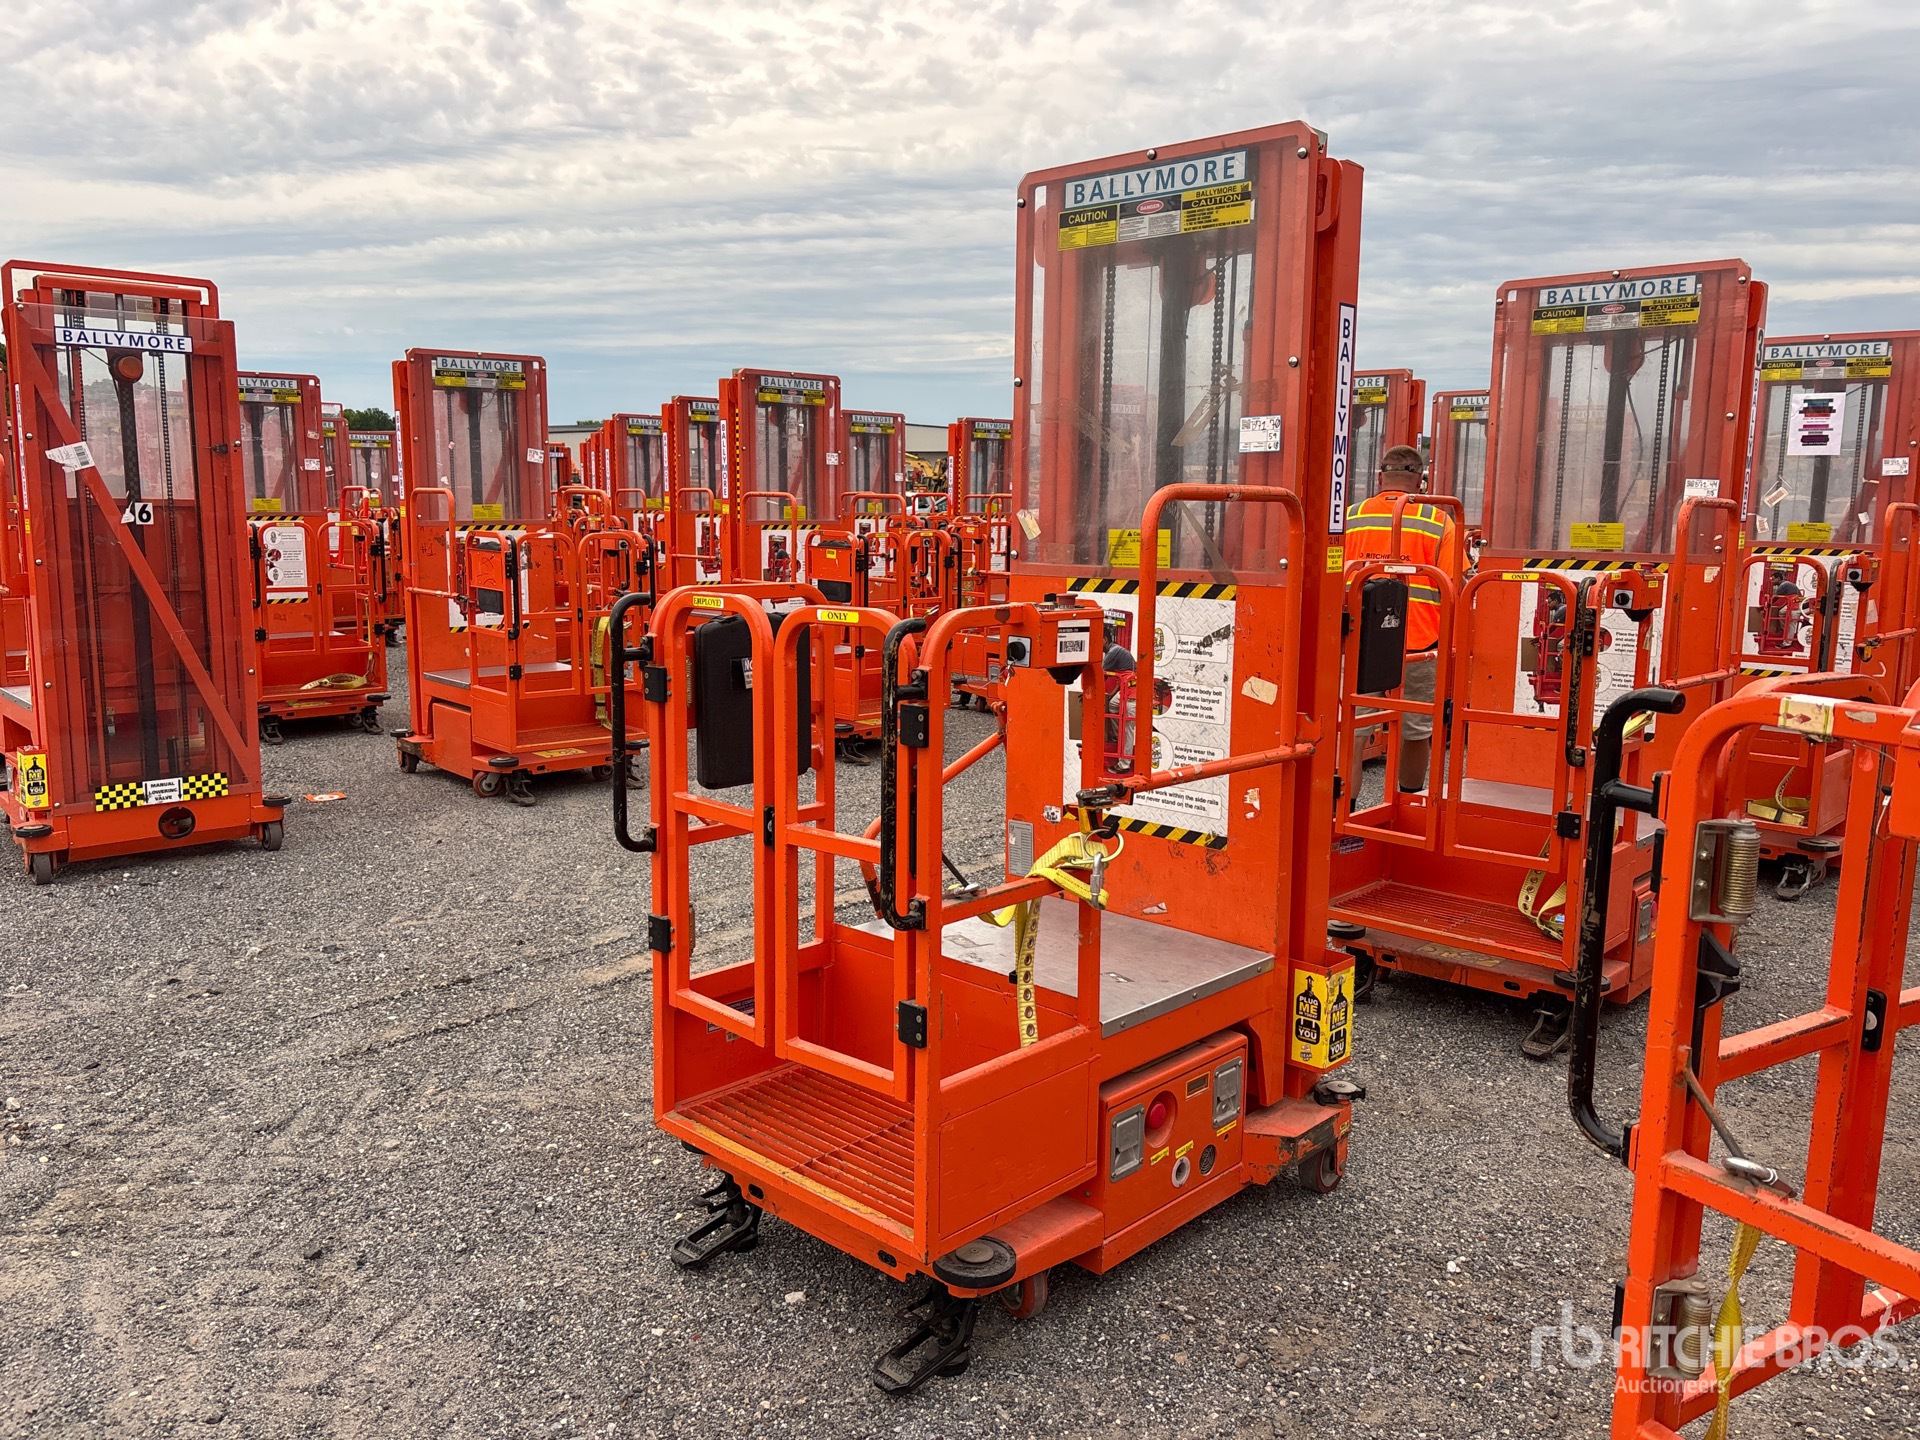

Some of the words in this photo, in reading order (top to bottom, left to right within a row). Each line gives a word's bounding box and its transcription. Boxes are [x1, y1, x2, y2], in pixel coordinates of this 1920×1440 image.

[1073, 156, 1236, 204] BALLYMORE
[1196, 185, 1237, 198] BALLYMORE
[1191, 194, 1241, 207] CAUTION
[1068, 209, 1108, 225] CAUTION
[1547, 278, 1688, 304] BALLYMORE
[1649, 303, 1692, 311] CAUTION
[1541, 309, 1577, 318] CAUTION
[63, 330, 186, 350] BALLYMORE
[1756, 333, 1764, 367] 3
[1771, 343, 1882, 358] BALLYMORE
[441, 359, 518, 371] BALLYMORE
[239, 378, 294, 388] LLYMORE
[764, 378, 821, 390] BALLYMORE
[695, 402, 719, 410] BALLY
[1456, 397, 1488, 405] BALLY
[1333, 318, 1351, 523] BALLYMORE
[138, 503, 152, 523] 6
[827, 611, 849, 621] ONLY
[149, 788, 177, 796] LOWERING
[1161, 798, 1175, 806] stand
[1299, 995, 1318, 1006] PLUG
[1299, 1002, 1318, 1015] ME
[1332, 1008, 1346, 1024] ME
[1299, 1029, 1317, 1040] YOU
[1330, 1042, 1345, 1054] YOU
